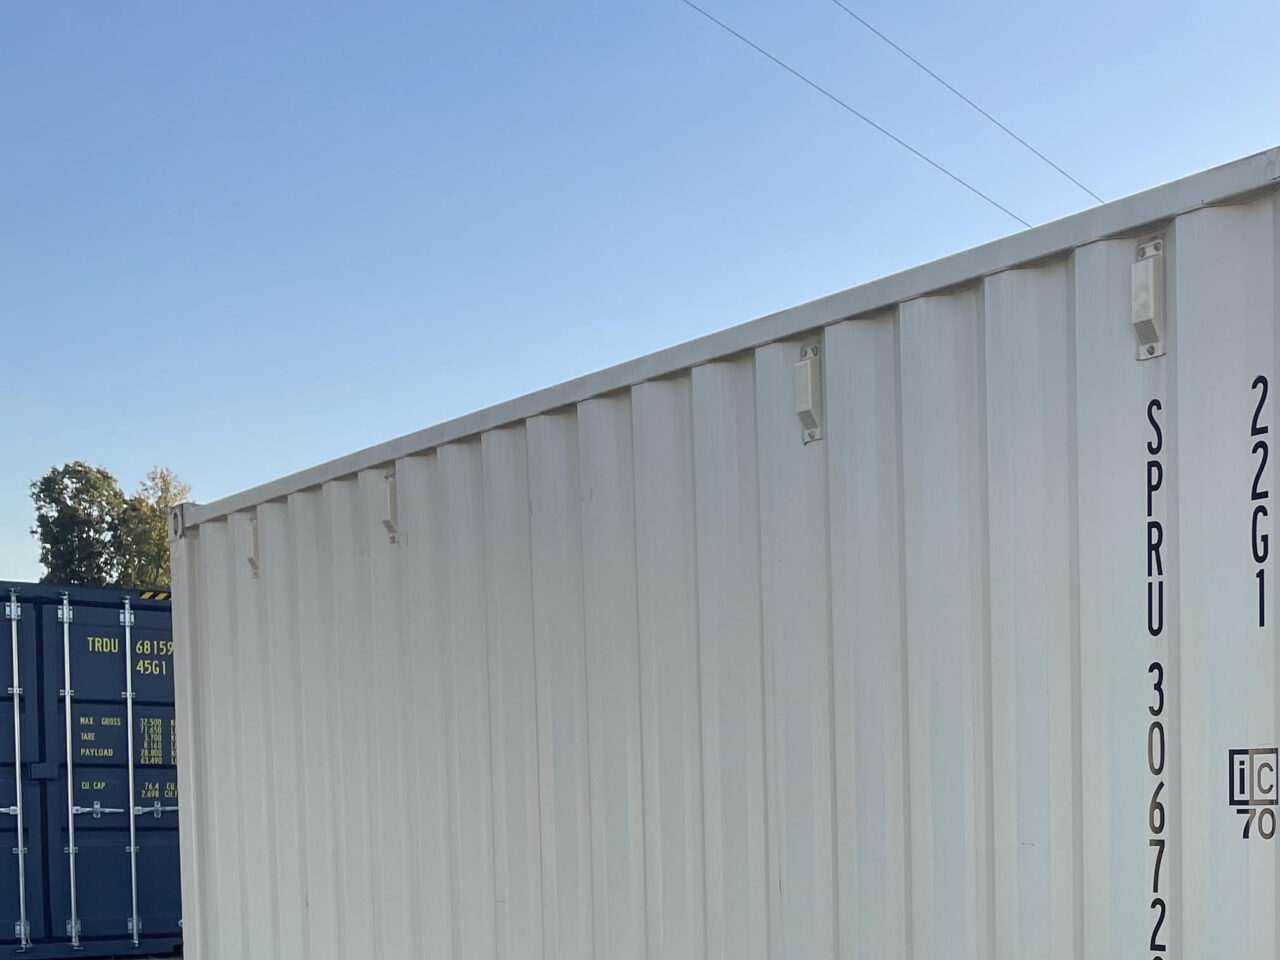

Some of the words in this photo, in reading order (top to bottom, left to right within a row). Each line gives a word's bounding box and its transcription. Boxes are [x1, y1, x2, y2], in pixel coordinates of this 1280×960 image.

[1250, 375, 1269, 627] 22G1
[1147, 399, 1163, 636] SPRU
[87, 637, 119, 653] TRDU
[136, 640, 175, 656] 68159
[136, 660, 166, 675] 45G1
[80, 717, 94, 725] MAX
[81, 732, 95, 741] TARE
[81, 748, 113, 756] PAYLOAD
[1236, 808, 1277, 840] 70
